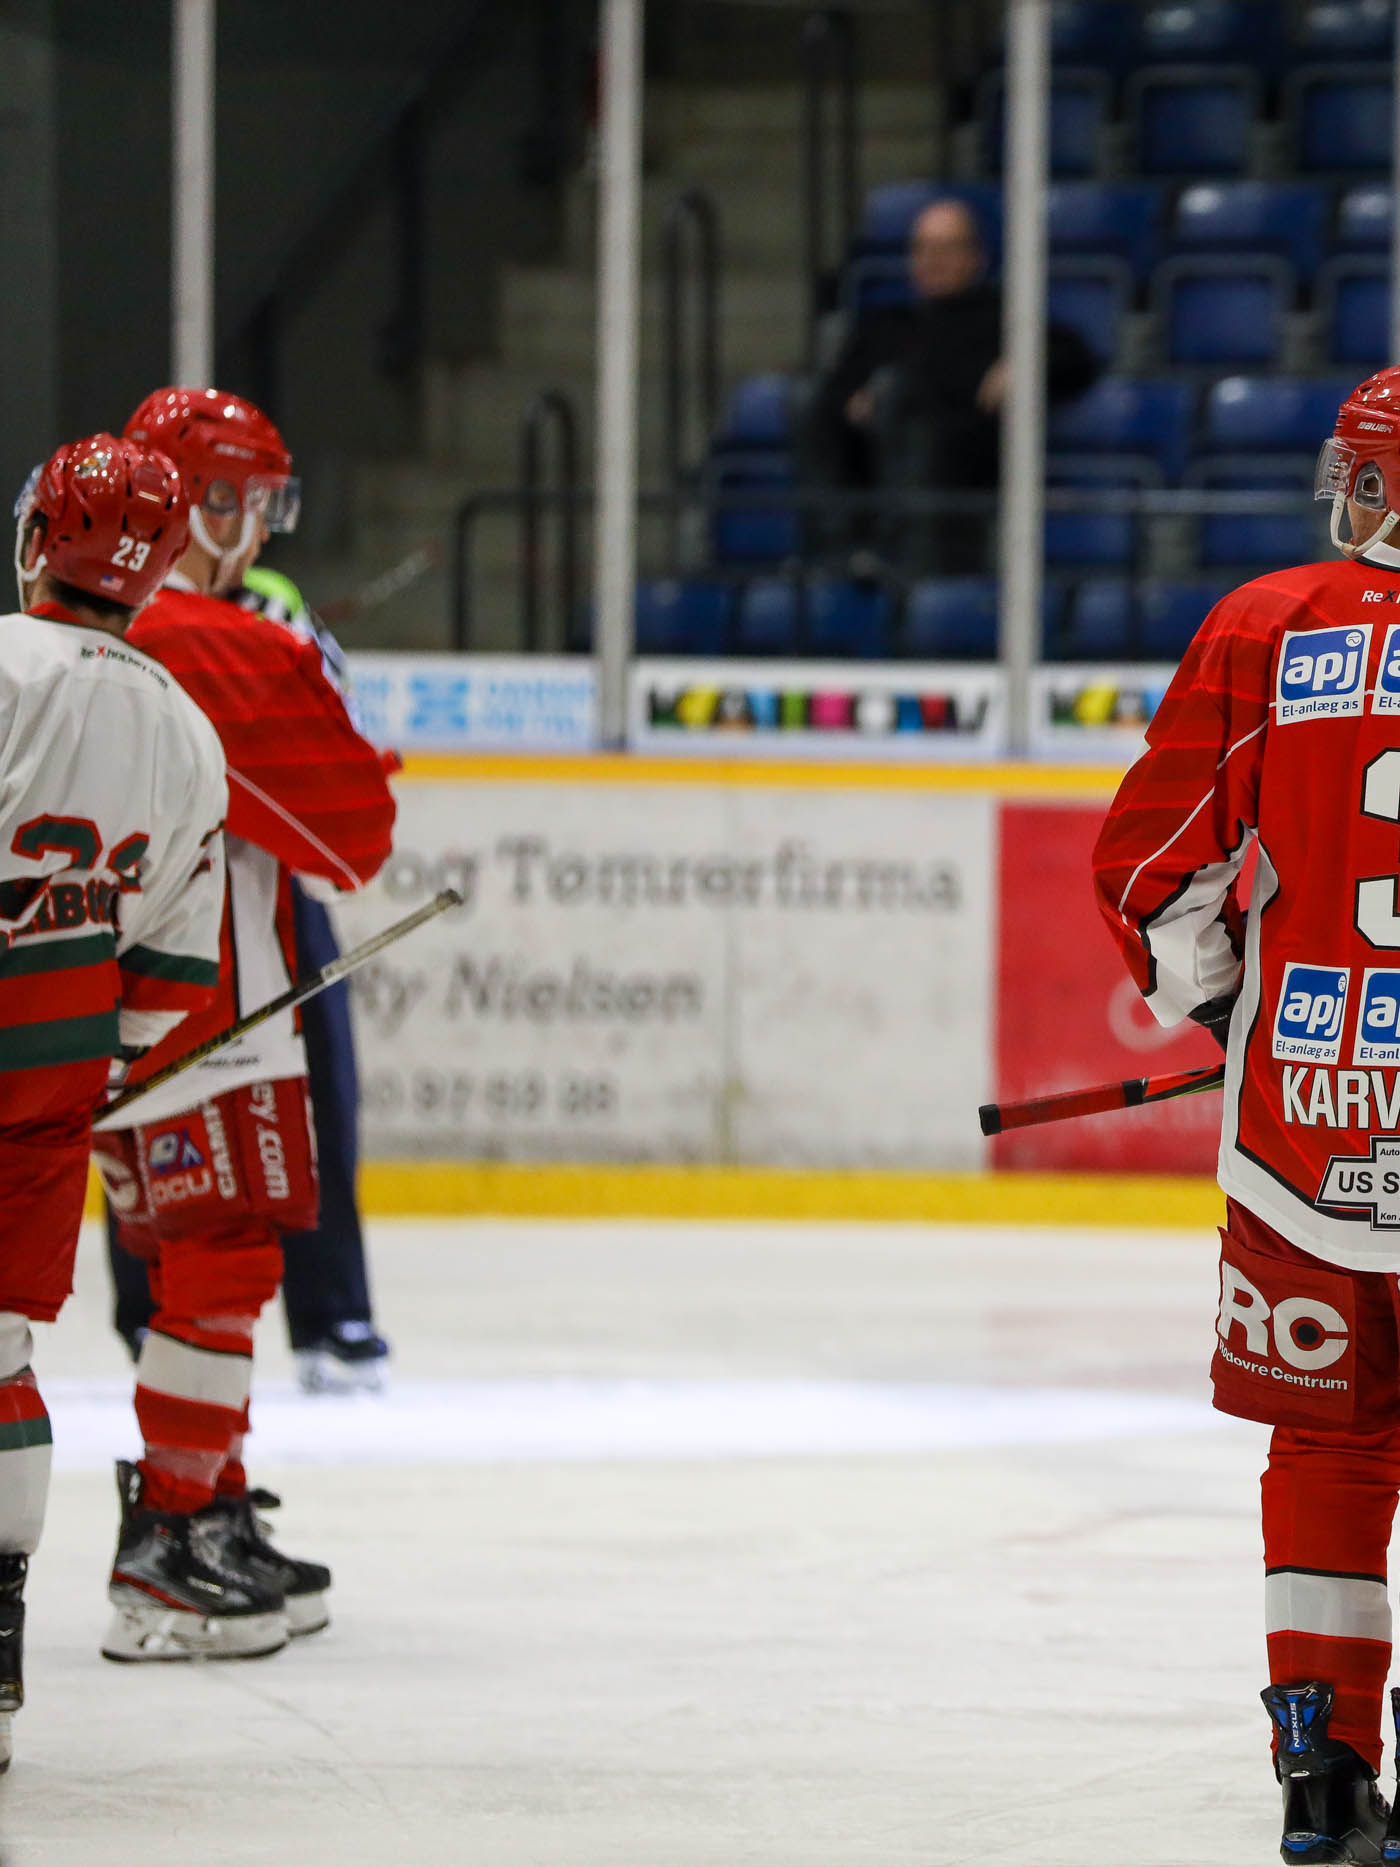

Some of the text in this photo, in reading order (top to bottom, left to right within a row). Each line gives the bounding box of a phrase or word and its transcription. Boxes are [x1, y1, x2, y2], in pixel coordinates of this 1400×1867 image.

[1357, 421, 1394, 434] BAUER
[111, 536, 151, 573] 23
[1284, 632, 1362, 691] apj
[1282, 700, 1339, 717] El-anlæg
[1283, 975, 1347, 1037] apj
[1275, 1040, 1323, 1057] El-anlæg
[1338, 1170, 1373, 1194] US
[1380, 1212, 1397, 1221] Ken
[1217, 1260, 1349, 1371] RC
[1270, 1367, 1348, 1390] Centrum
[1290, 1702, 1301, 1748] NEXUS
